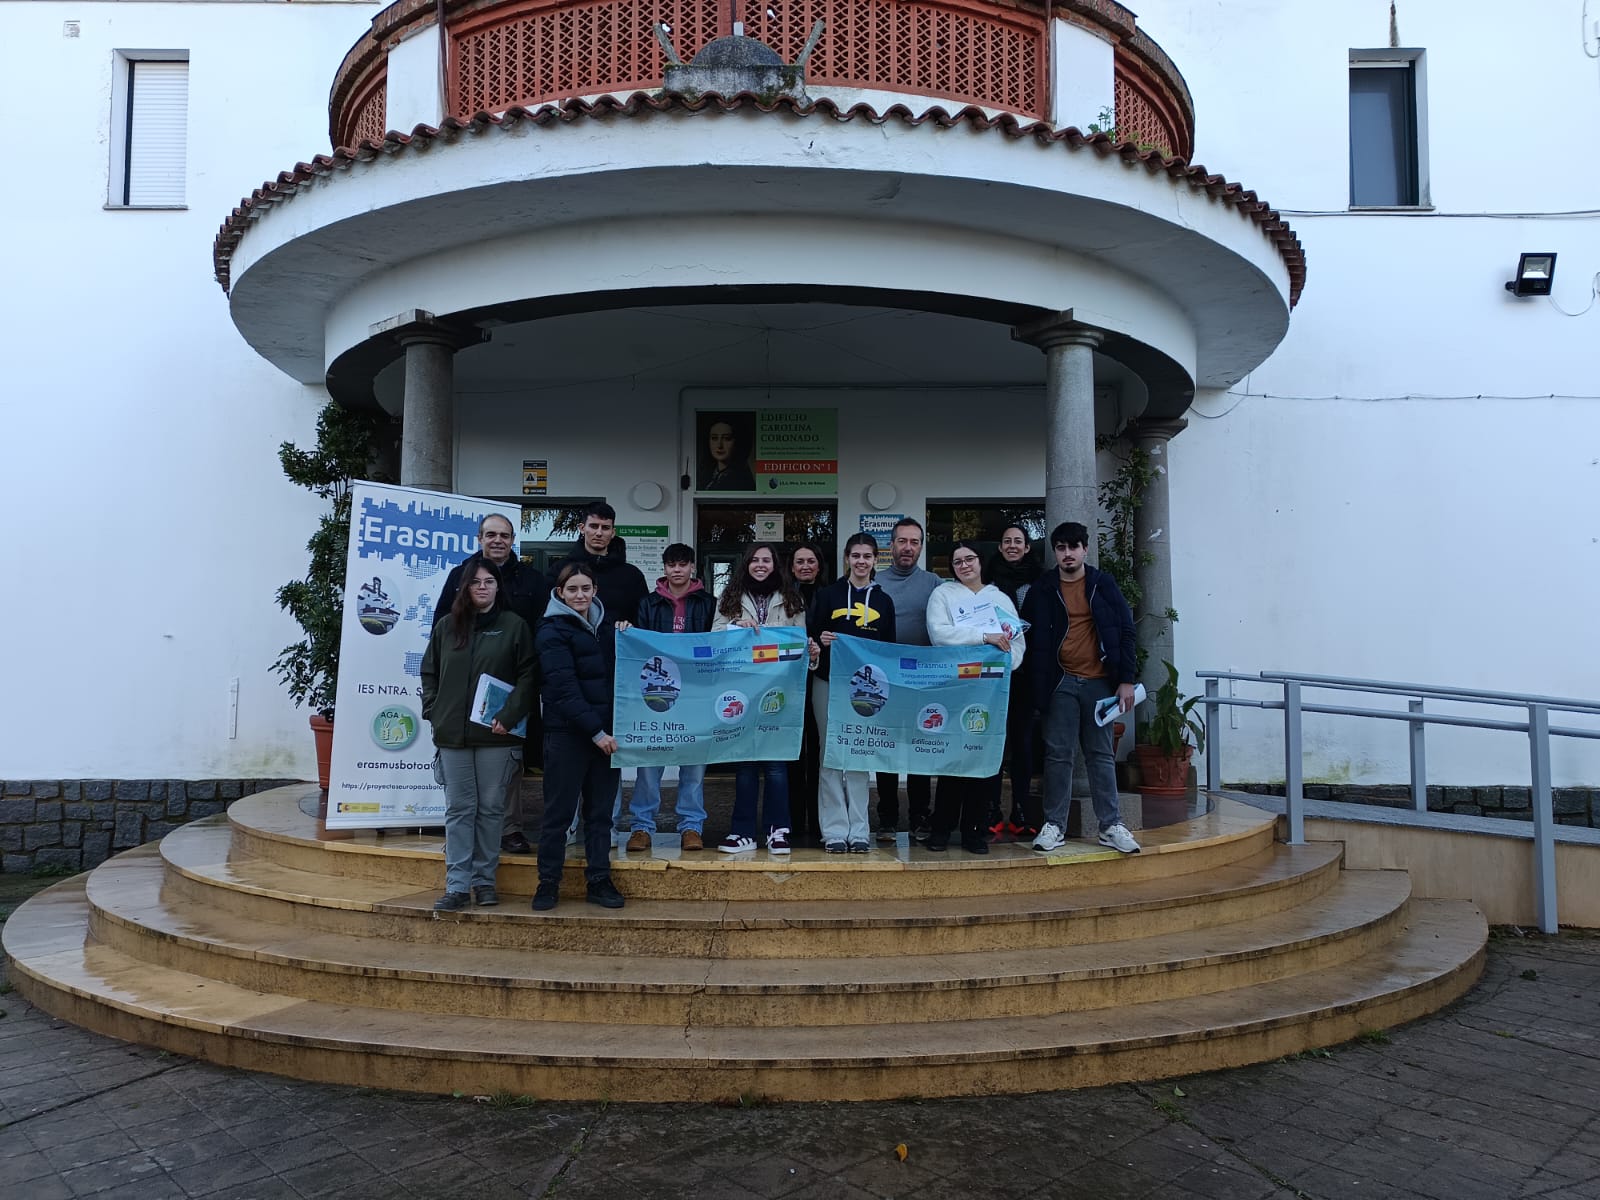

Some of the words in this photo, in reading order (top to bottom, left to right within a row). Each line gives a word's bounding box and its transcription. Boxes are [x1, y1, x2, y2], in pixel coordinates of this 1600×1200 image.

[760, 413, 807, 421] EDIFICIO
[760, 434, 820, 442] CORONADO
[764, 463, 810, 471] EDIFICIO
[358, 684, 374, 694] IES
[378, 685, 412, 696] NTRA.
[633, 721, 661, 731] I.E.S.
[663, 721, 688, 731] Ntra.
[841, 724, 864, 734] I.E.S.
[866, 726, 889, 736] Ntra.
[625, 734, 647, 743] Sra.
[650, 734, 662, 743] de
[837, 736, 851, 746] Sra.
[854, 737, 865, 746] de
[867, 737, 896, 749] Bótoa
